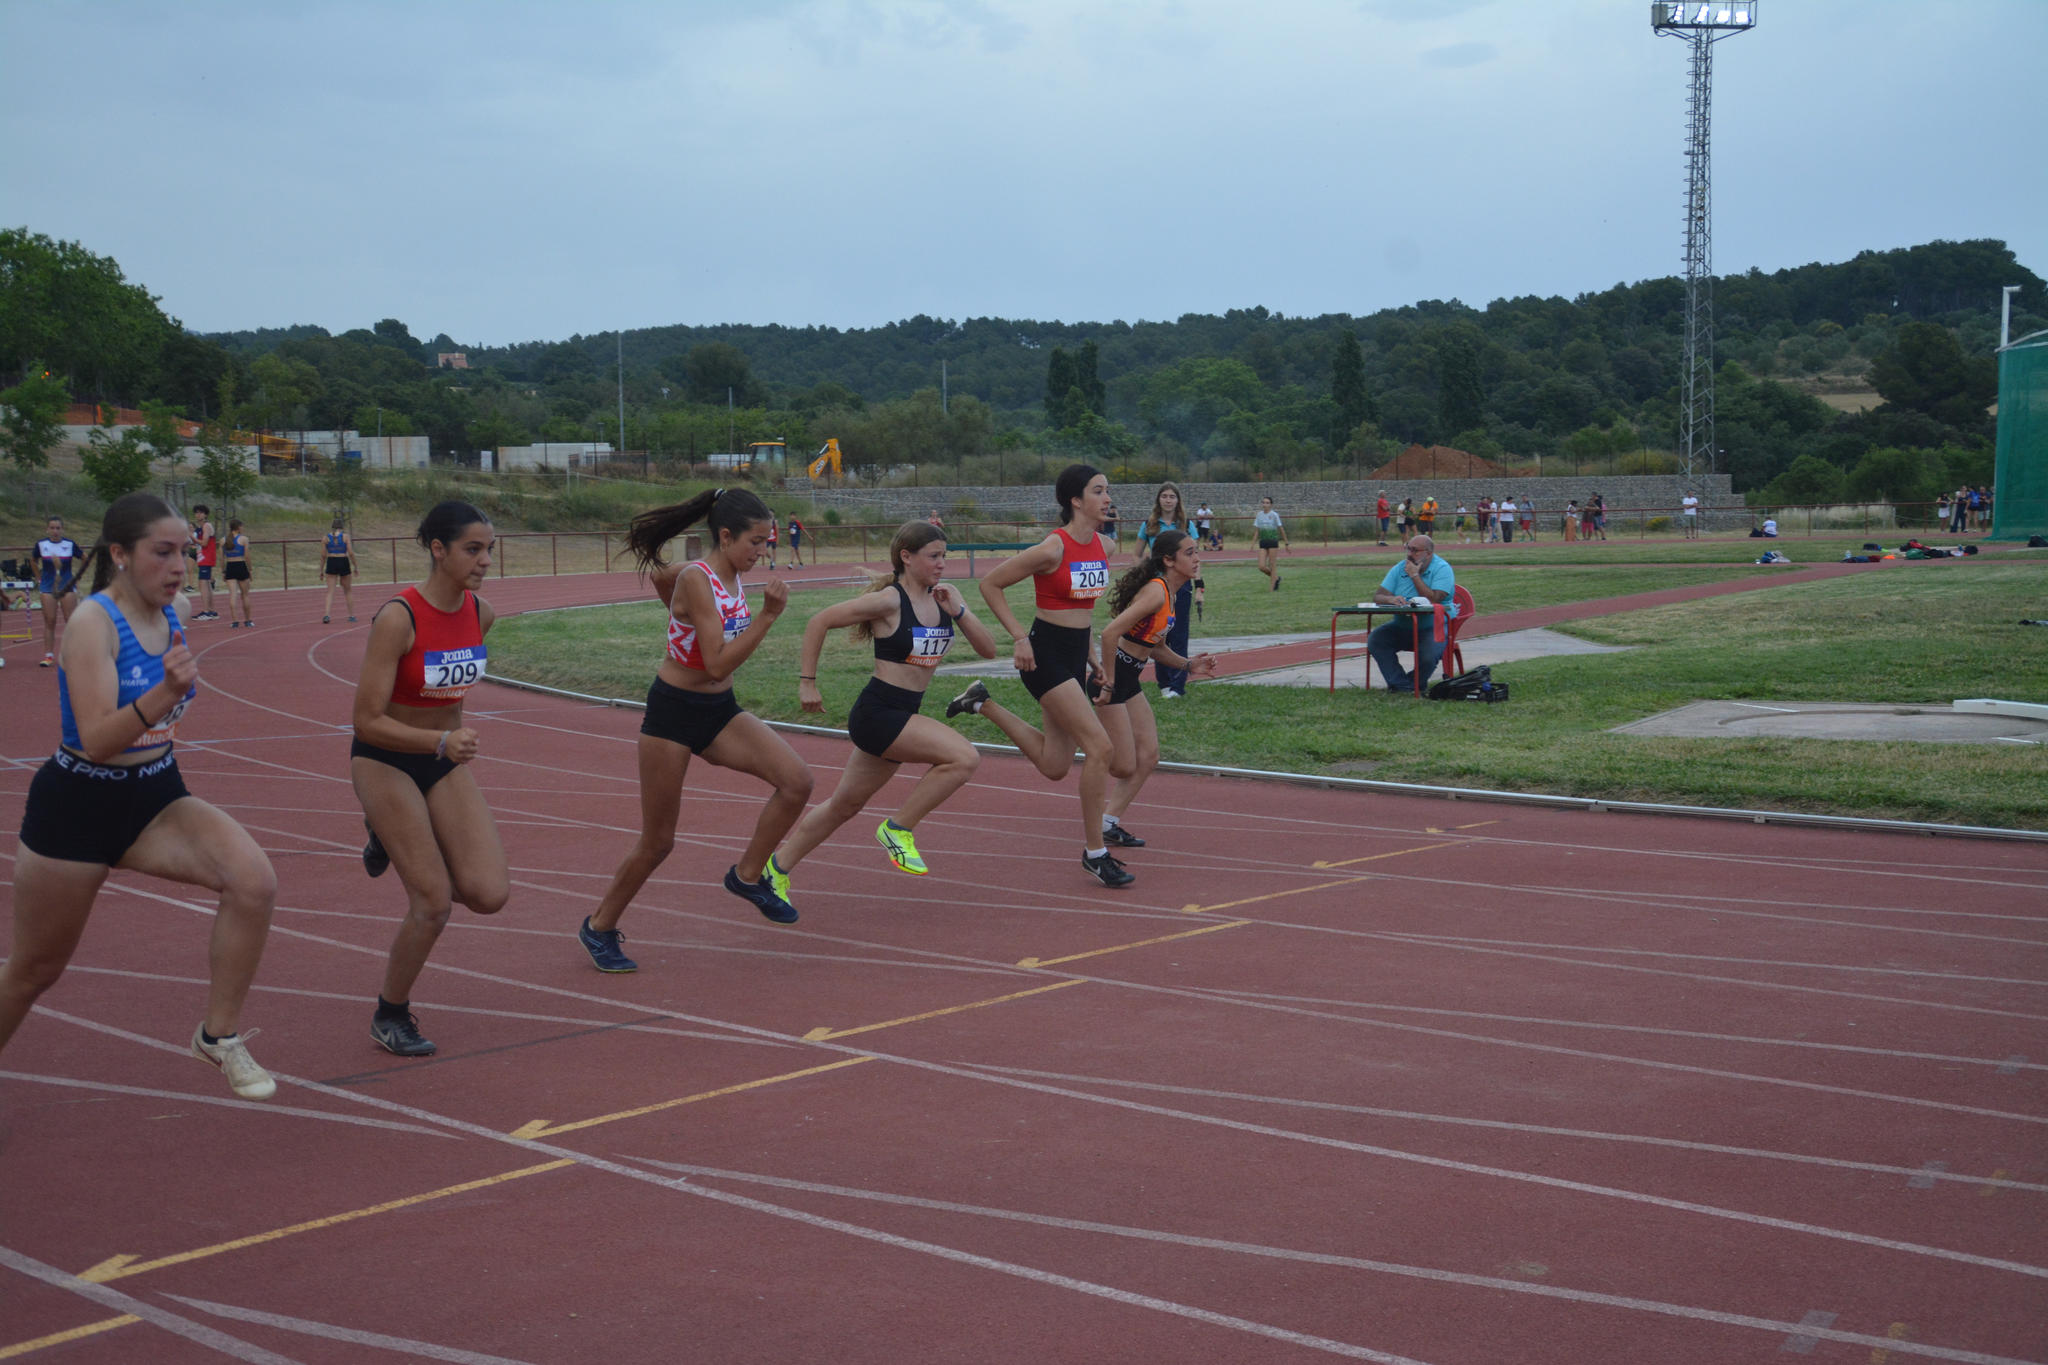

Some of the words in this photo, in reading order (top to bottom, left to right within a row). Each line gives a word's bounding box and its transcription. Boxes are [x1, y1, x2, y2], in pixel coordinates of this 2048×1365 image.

[1080, 571, 1104, 588] 204
[441, 648, 474, 664] Joma
[920, 639, 950, 656] 117
[437, 662, 477, 688] 209
[71, 762, 129, 780] PRO
